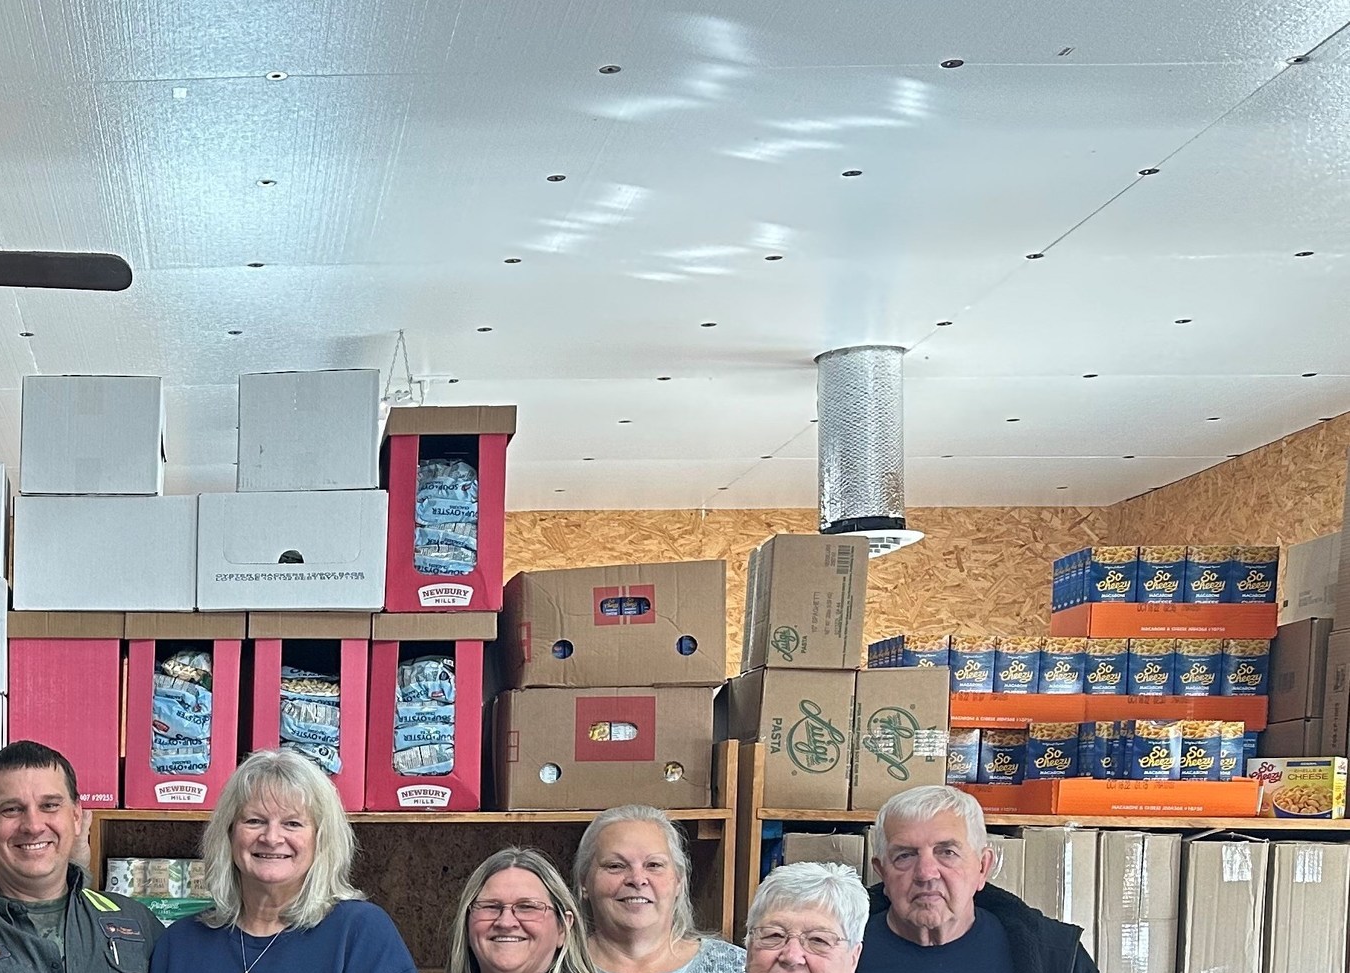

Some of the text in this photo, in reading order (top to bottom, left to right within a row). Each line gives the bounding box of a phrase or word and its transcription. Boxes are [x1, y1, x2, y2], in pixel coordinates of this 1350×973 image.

[1107, 571, 1124, 582] So
[1153, 571, 1171, 582] So
[1201, 570, 1219, 582] So
[1248, 570, 1266, 582] So
[422, 587, 470, 597] NEWBURY
[1096, 580, 1131, 593] Cheezy
[1144, 580, 1179, 593] Cheezy
[1191, 580, 1226, 593] Cheezy
[1237, 580, 1272, 593] Cheezy
[964, 660, 981, 671] So
[1009, 661, 1026, 672] So
[1054, 662, 1071, 673] So
[1098, 662, 1114, 674] So
[1144, 663, 1162, 674] So
[1190, 663, 1208, 675] So
[1237, 663, 1255, 675] So
[954, 670, 989, 683] Cheezy
[999, 670, 1033, 683] Cheezy
[1044, 671, 1079, 684] Cheezy
[1087, 672, 1122, 685] Cheezy
[1134, 672, 1169, 685] Cheezy
[1180, 672, 1215, 685] Cheezy
[1227, 672, 1262, 686] Cheezy
[770, 717, 783, 754] PASTA
[787, 699, 846, 773] Luigi
[950, 751, 965, 763] So
[994, 753, 1012, 764] So
[1044, 747, 1064, 760] So
[1150, 746, 1168, 759] So
[1187, 746, 1206, 759] So
[156, 764, 184, 772] OYSTER
[947, 762, 973, 774] heezy
[984, 762, 1019, 776] Cheezy
[1034, 757, 1071, 770] Cheezy
[1138, 756, 1176, 770] Cheezy
[1180, 756, 1215, 770] Cheezy
[1258, 762, 1276, 774] So
[1251, 771, 1283, 783] Cheezy
[159, 785, 203, 794] NEWBURY
[401, 789, 447, 798] NEWBURY
